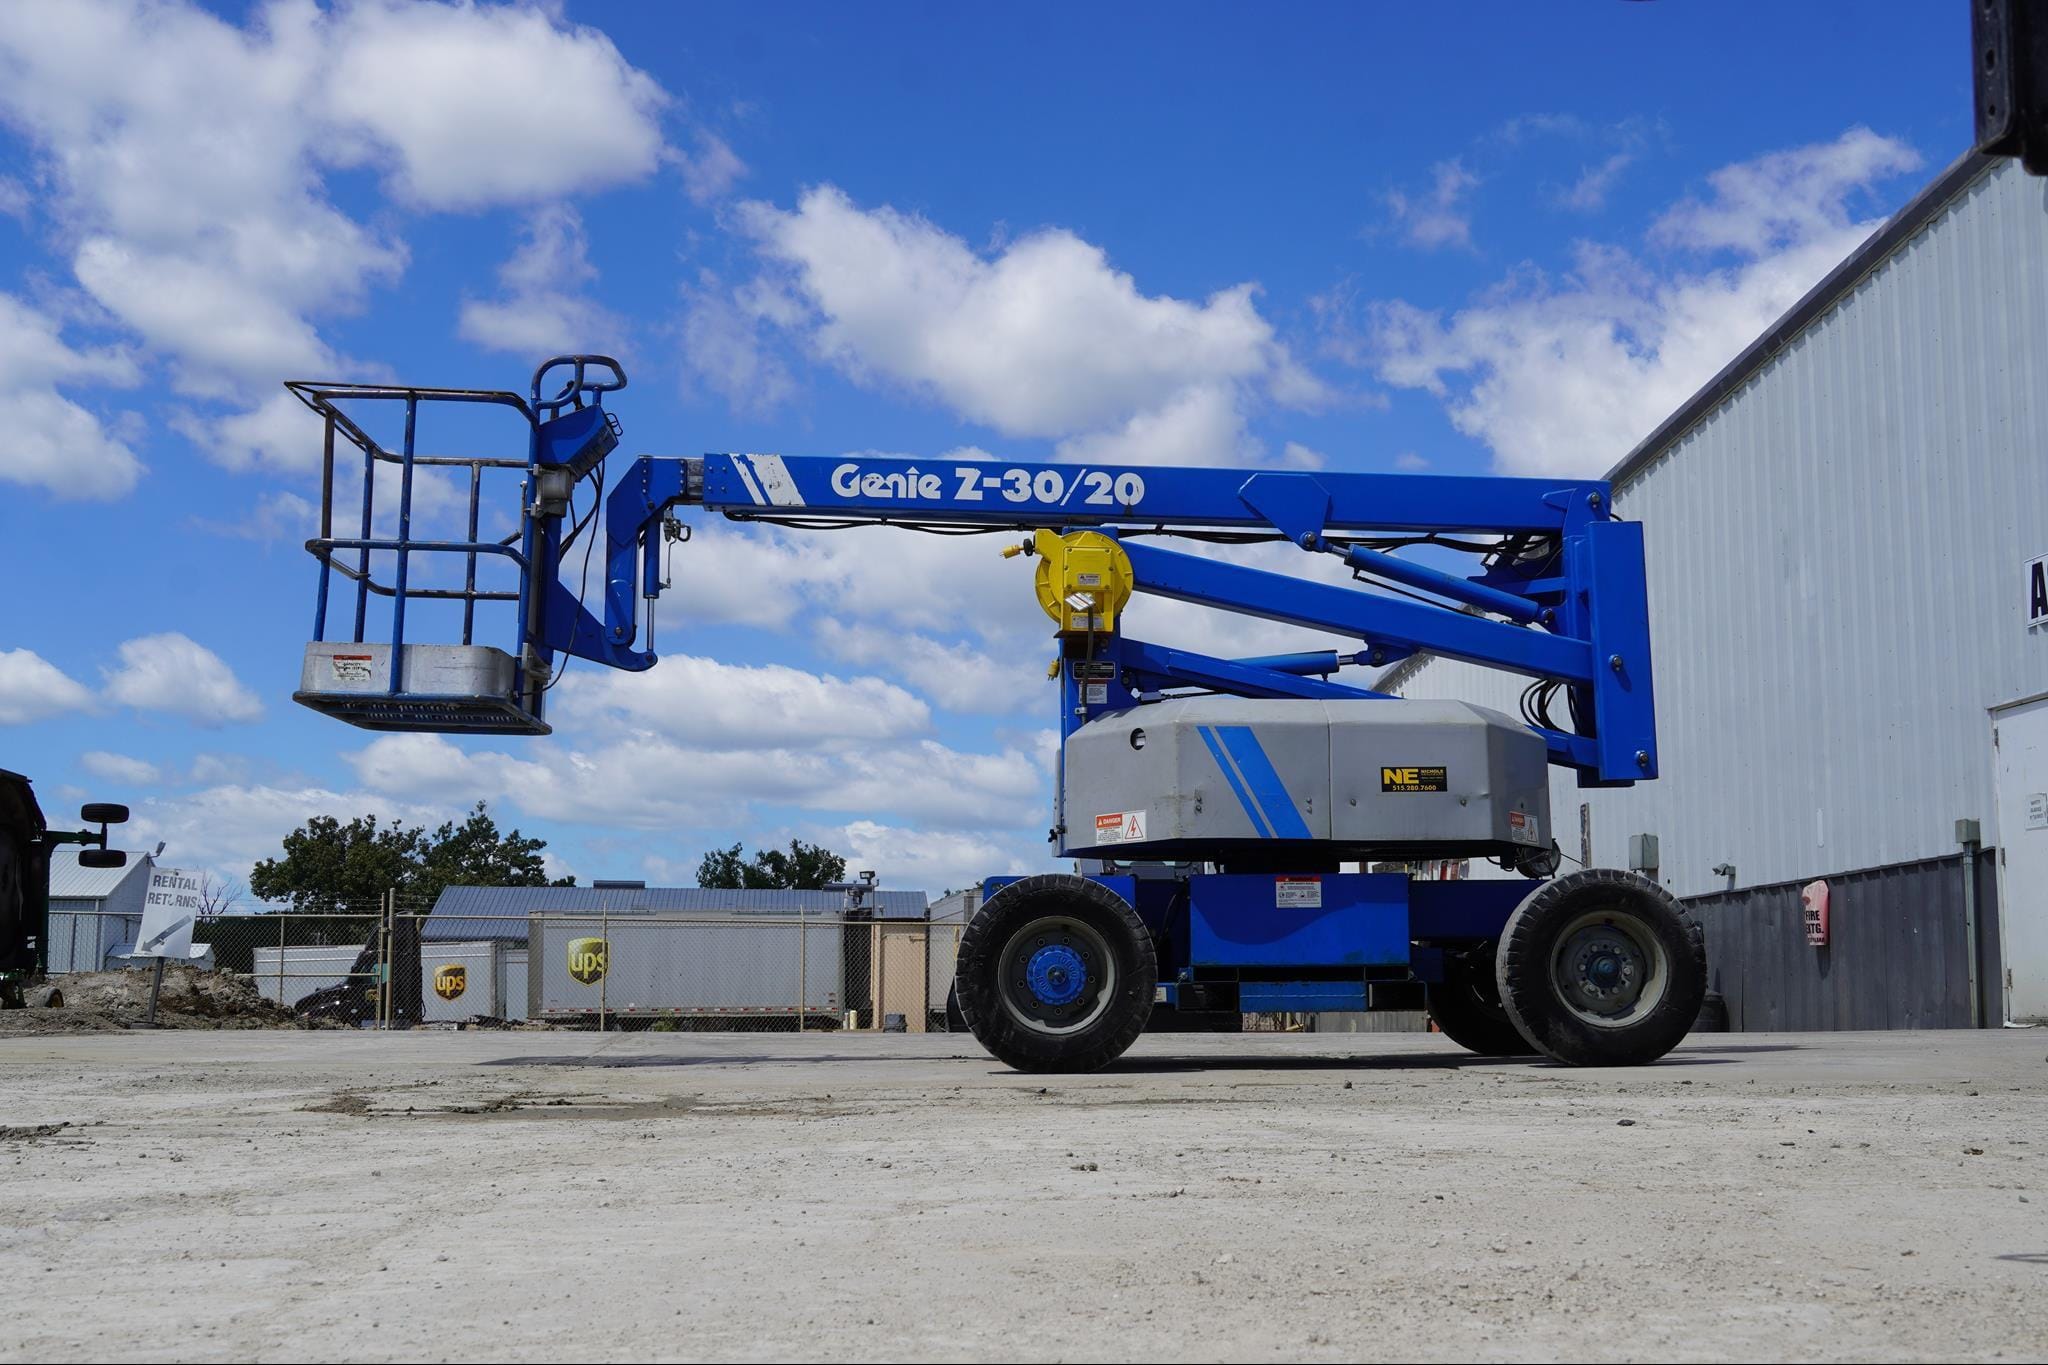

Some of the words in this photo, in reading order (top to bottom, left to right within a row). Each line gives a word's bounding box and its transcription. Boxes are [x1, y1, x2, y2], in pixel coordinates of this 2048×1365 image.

[831, 463, 942, 499] Genie
[954, 467, 1145, 507] Z-30/20
[2031, 561, 2048, 619] A
[1384, 768, 1419, 785] NE
[152, 874, 198, 891] RENTAL
[570, 952, 608, 979] ups
[436, 975, 465, 996] ups
